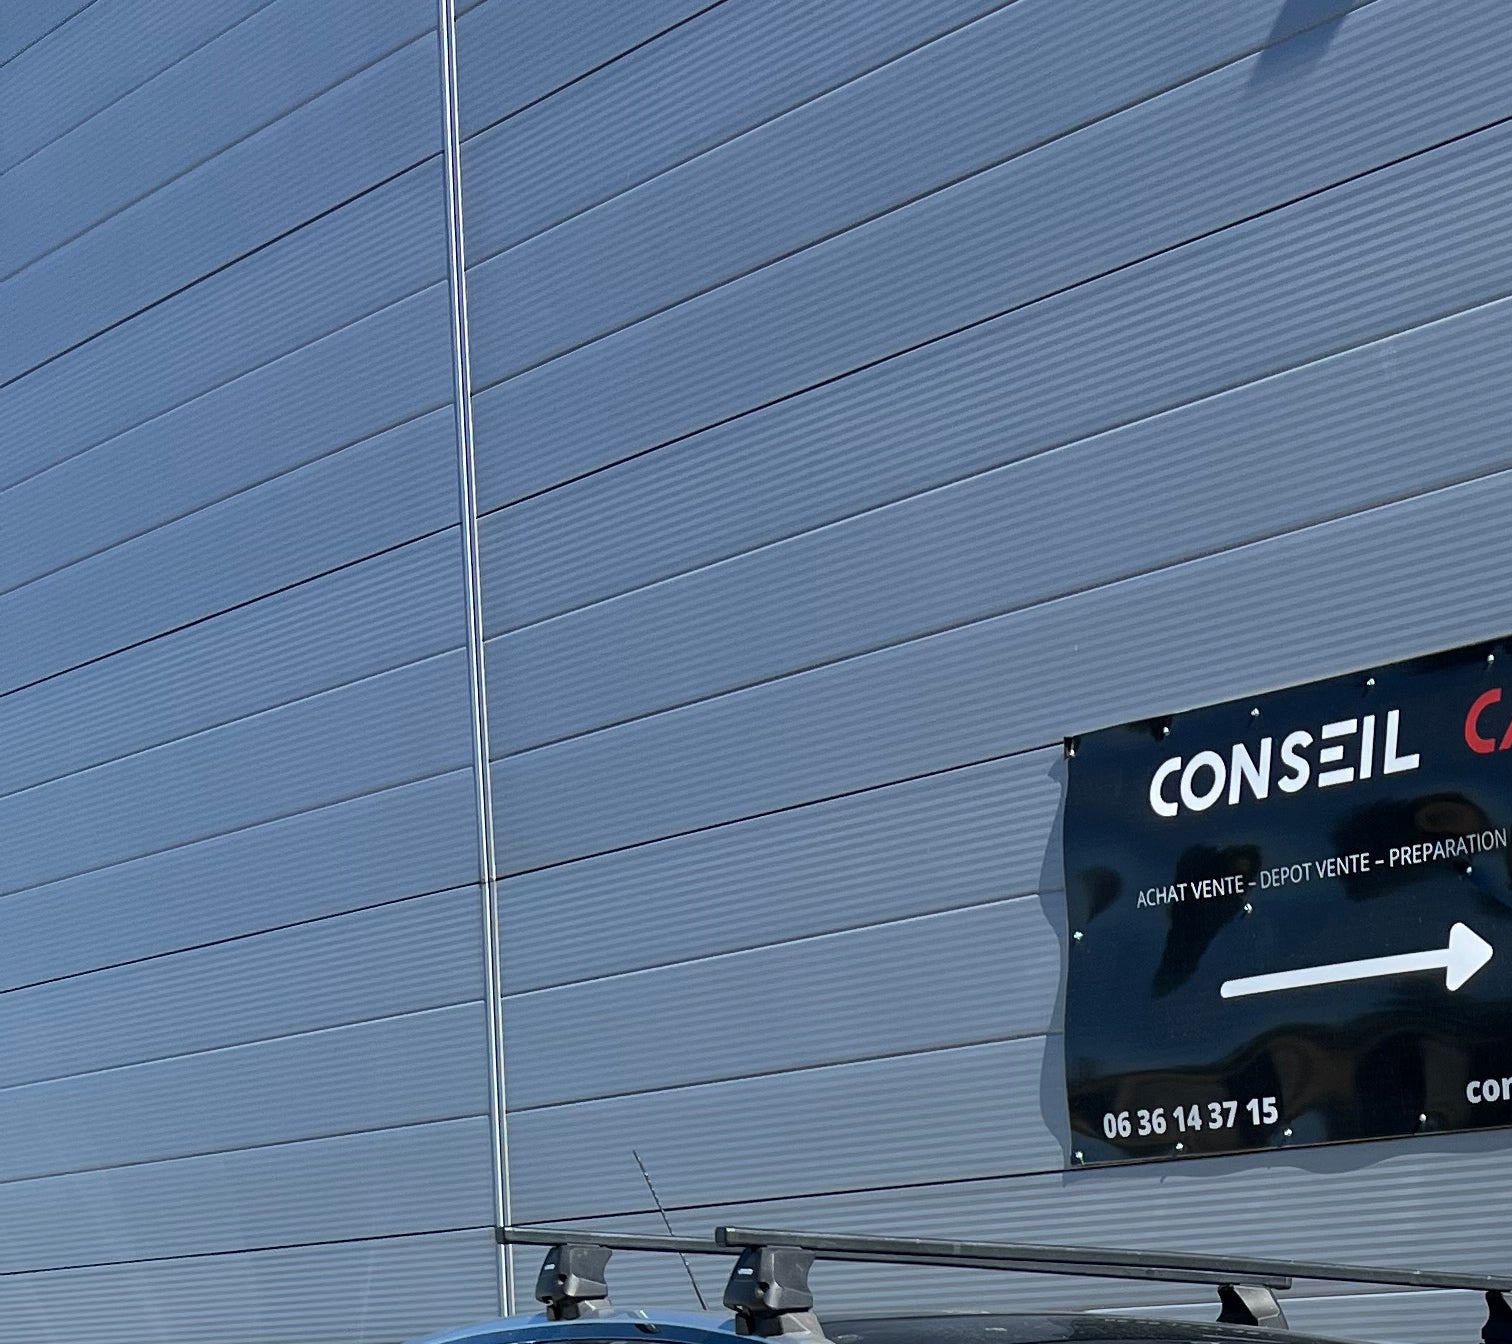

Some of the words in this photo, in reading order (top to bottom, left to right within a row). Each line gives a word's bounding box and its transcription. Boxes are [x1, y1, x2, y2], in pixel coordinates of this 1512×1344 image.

[1149, 709, 1420, 817] CONSEIL
[1136, 883, 1188, 909] ACHAT
[1190, 874, 1245, 900] VENTE
[1260, 862, 1313, 889] DEPOT
[1315, 853, 1371, 879] VENTE
[1389, 829, 1507, 868] PREPARATION
[1103, 1111, 1132, 1139] 06
[1137, 1107, 1167, 1136] 36
[1171, 1104, 1203, 1132] 14
[1207, 1100, 1238, 1130] 37
[1246, 1096, 1279, 1126] 15
